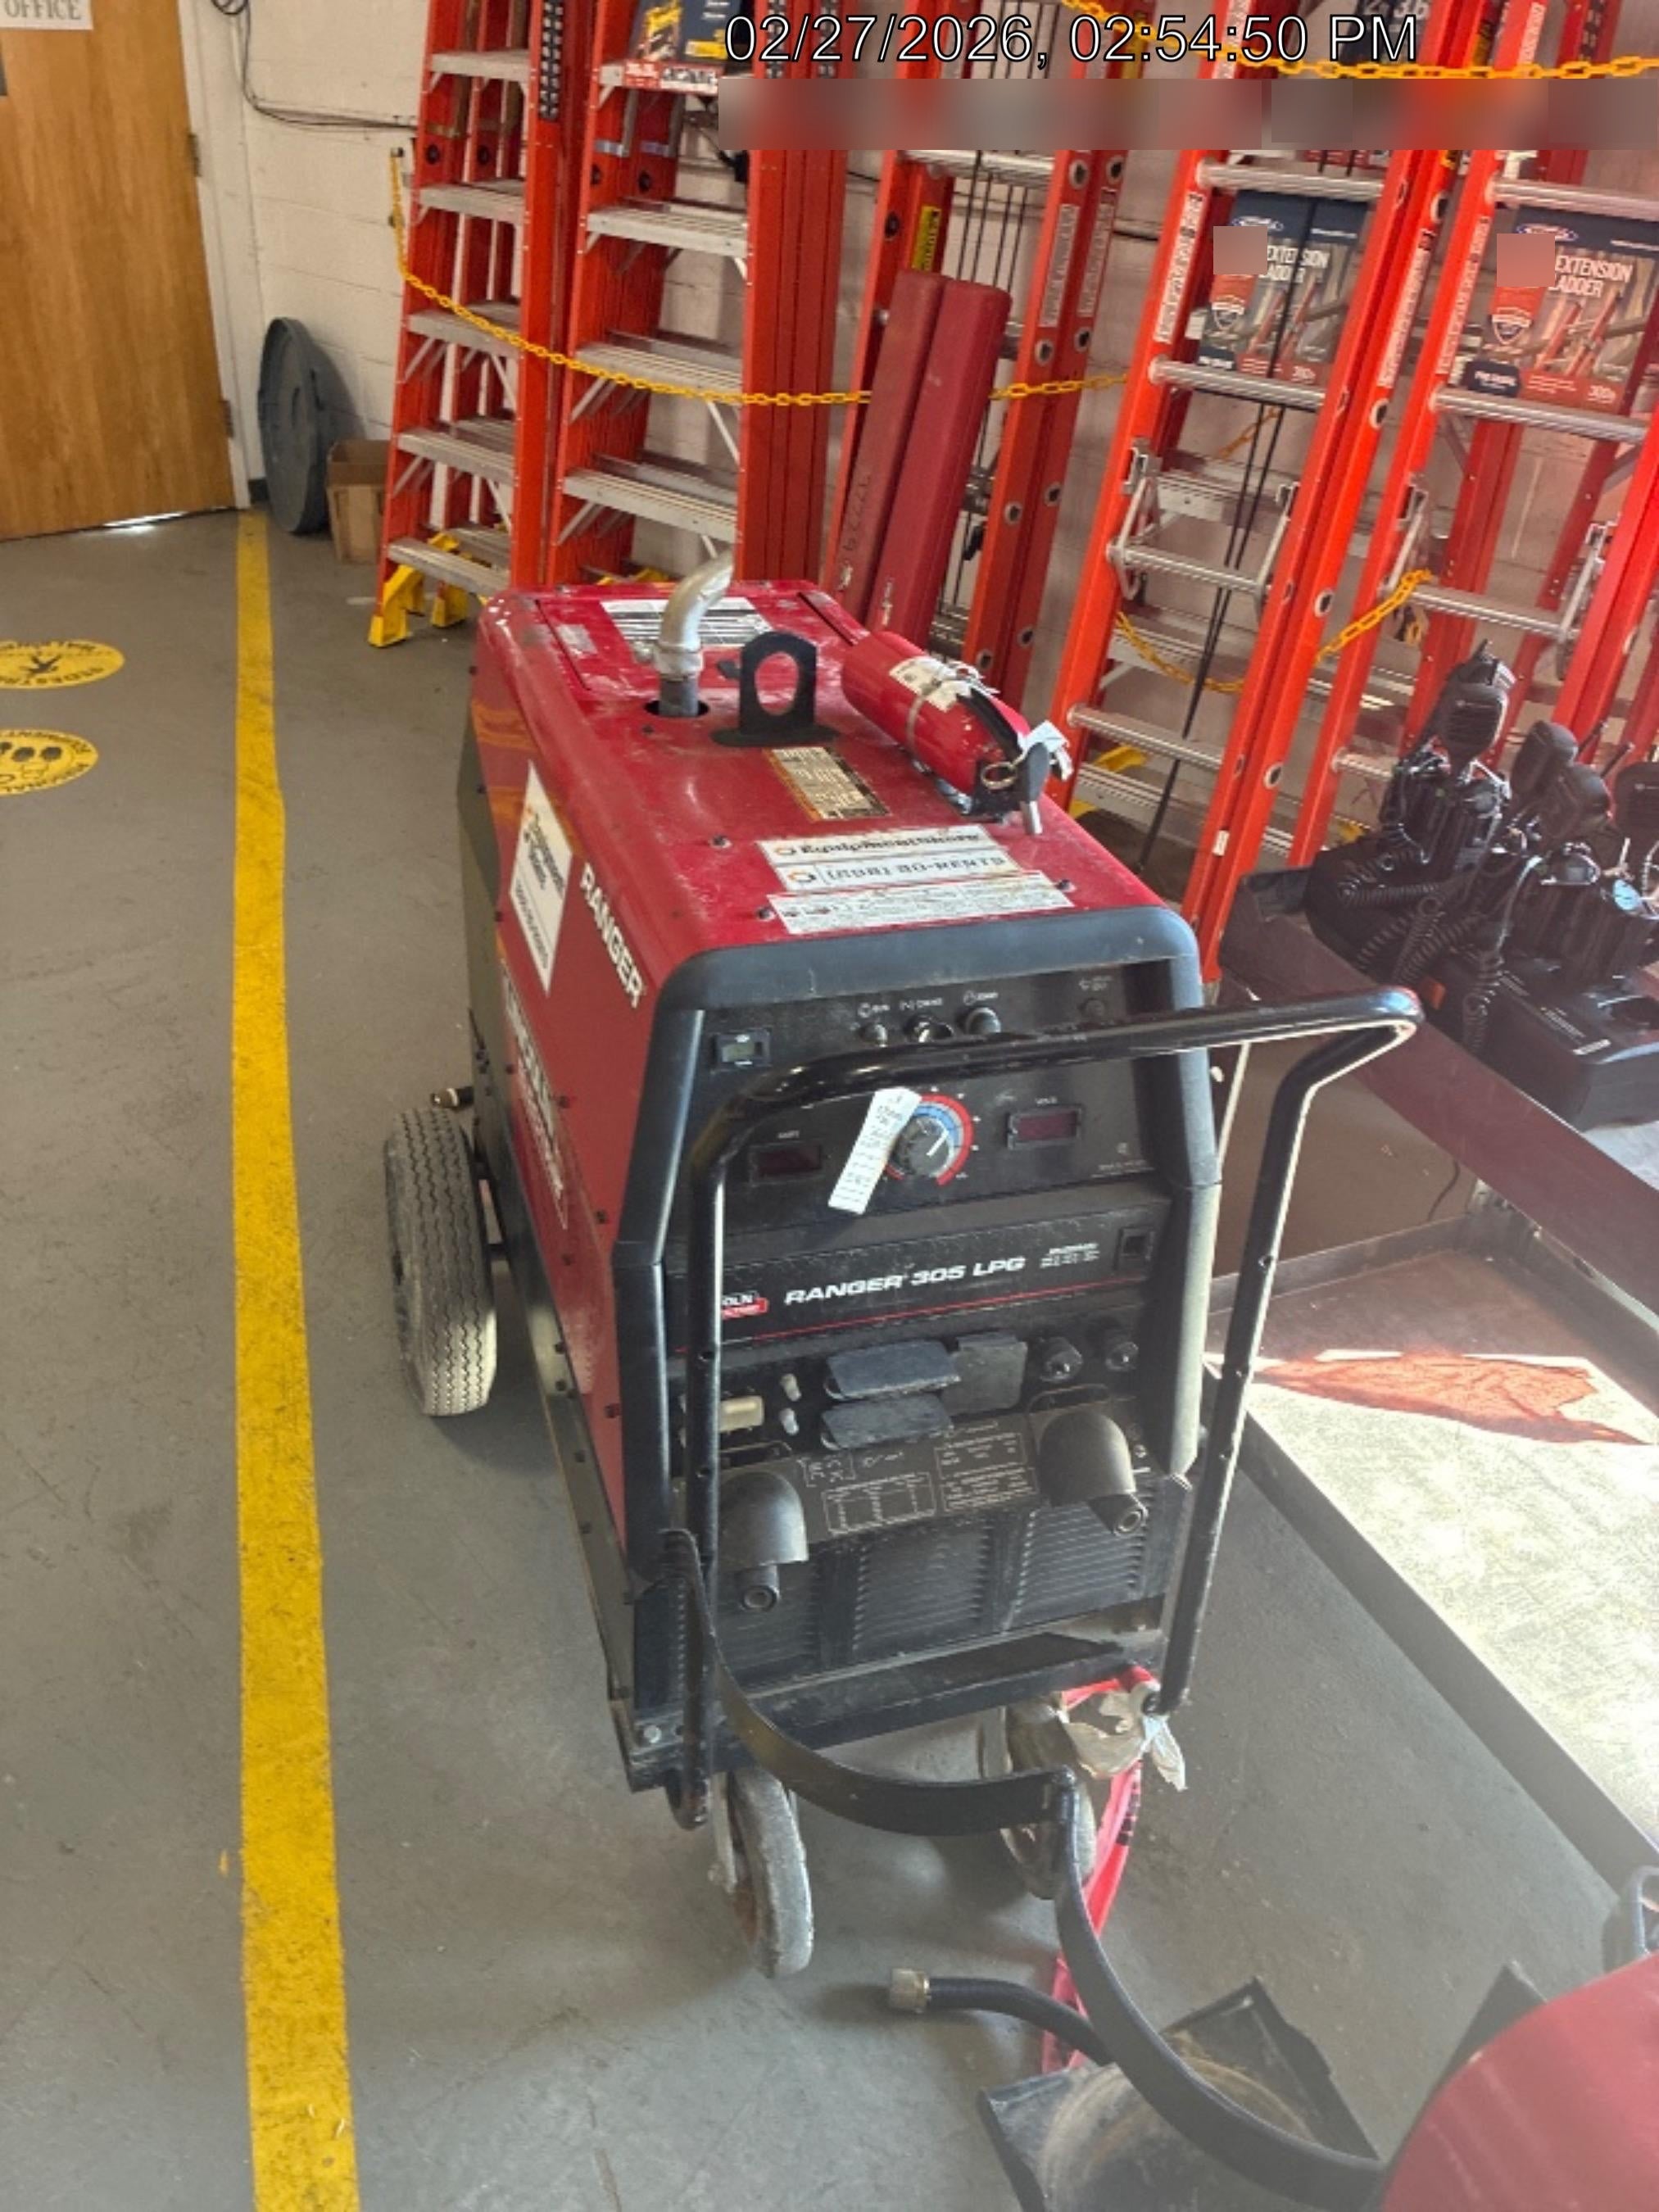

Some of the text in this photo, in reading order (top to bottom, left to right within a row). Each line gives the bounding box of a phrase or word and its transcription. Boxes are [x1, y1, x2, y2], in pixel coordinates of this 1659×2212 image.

[5, 0, 81, 20] OFFICE
[1267, 245, 1330, 270] EXTESION
[1555, 255, 1634, 283] EXTENSION
[580, 862, 646, 1009] RANGER
[784, 1274, 904, 1305] RANGER
[910, 1264, 966, 1286] 305
[972, 1256, 1026, 1276] LPG
